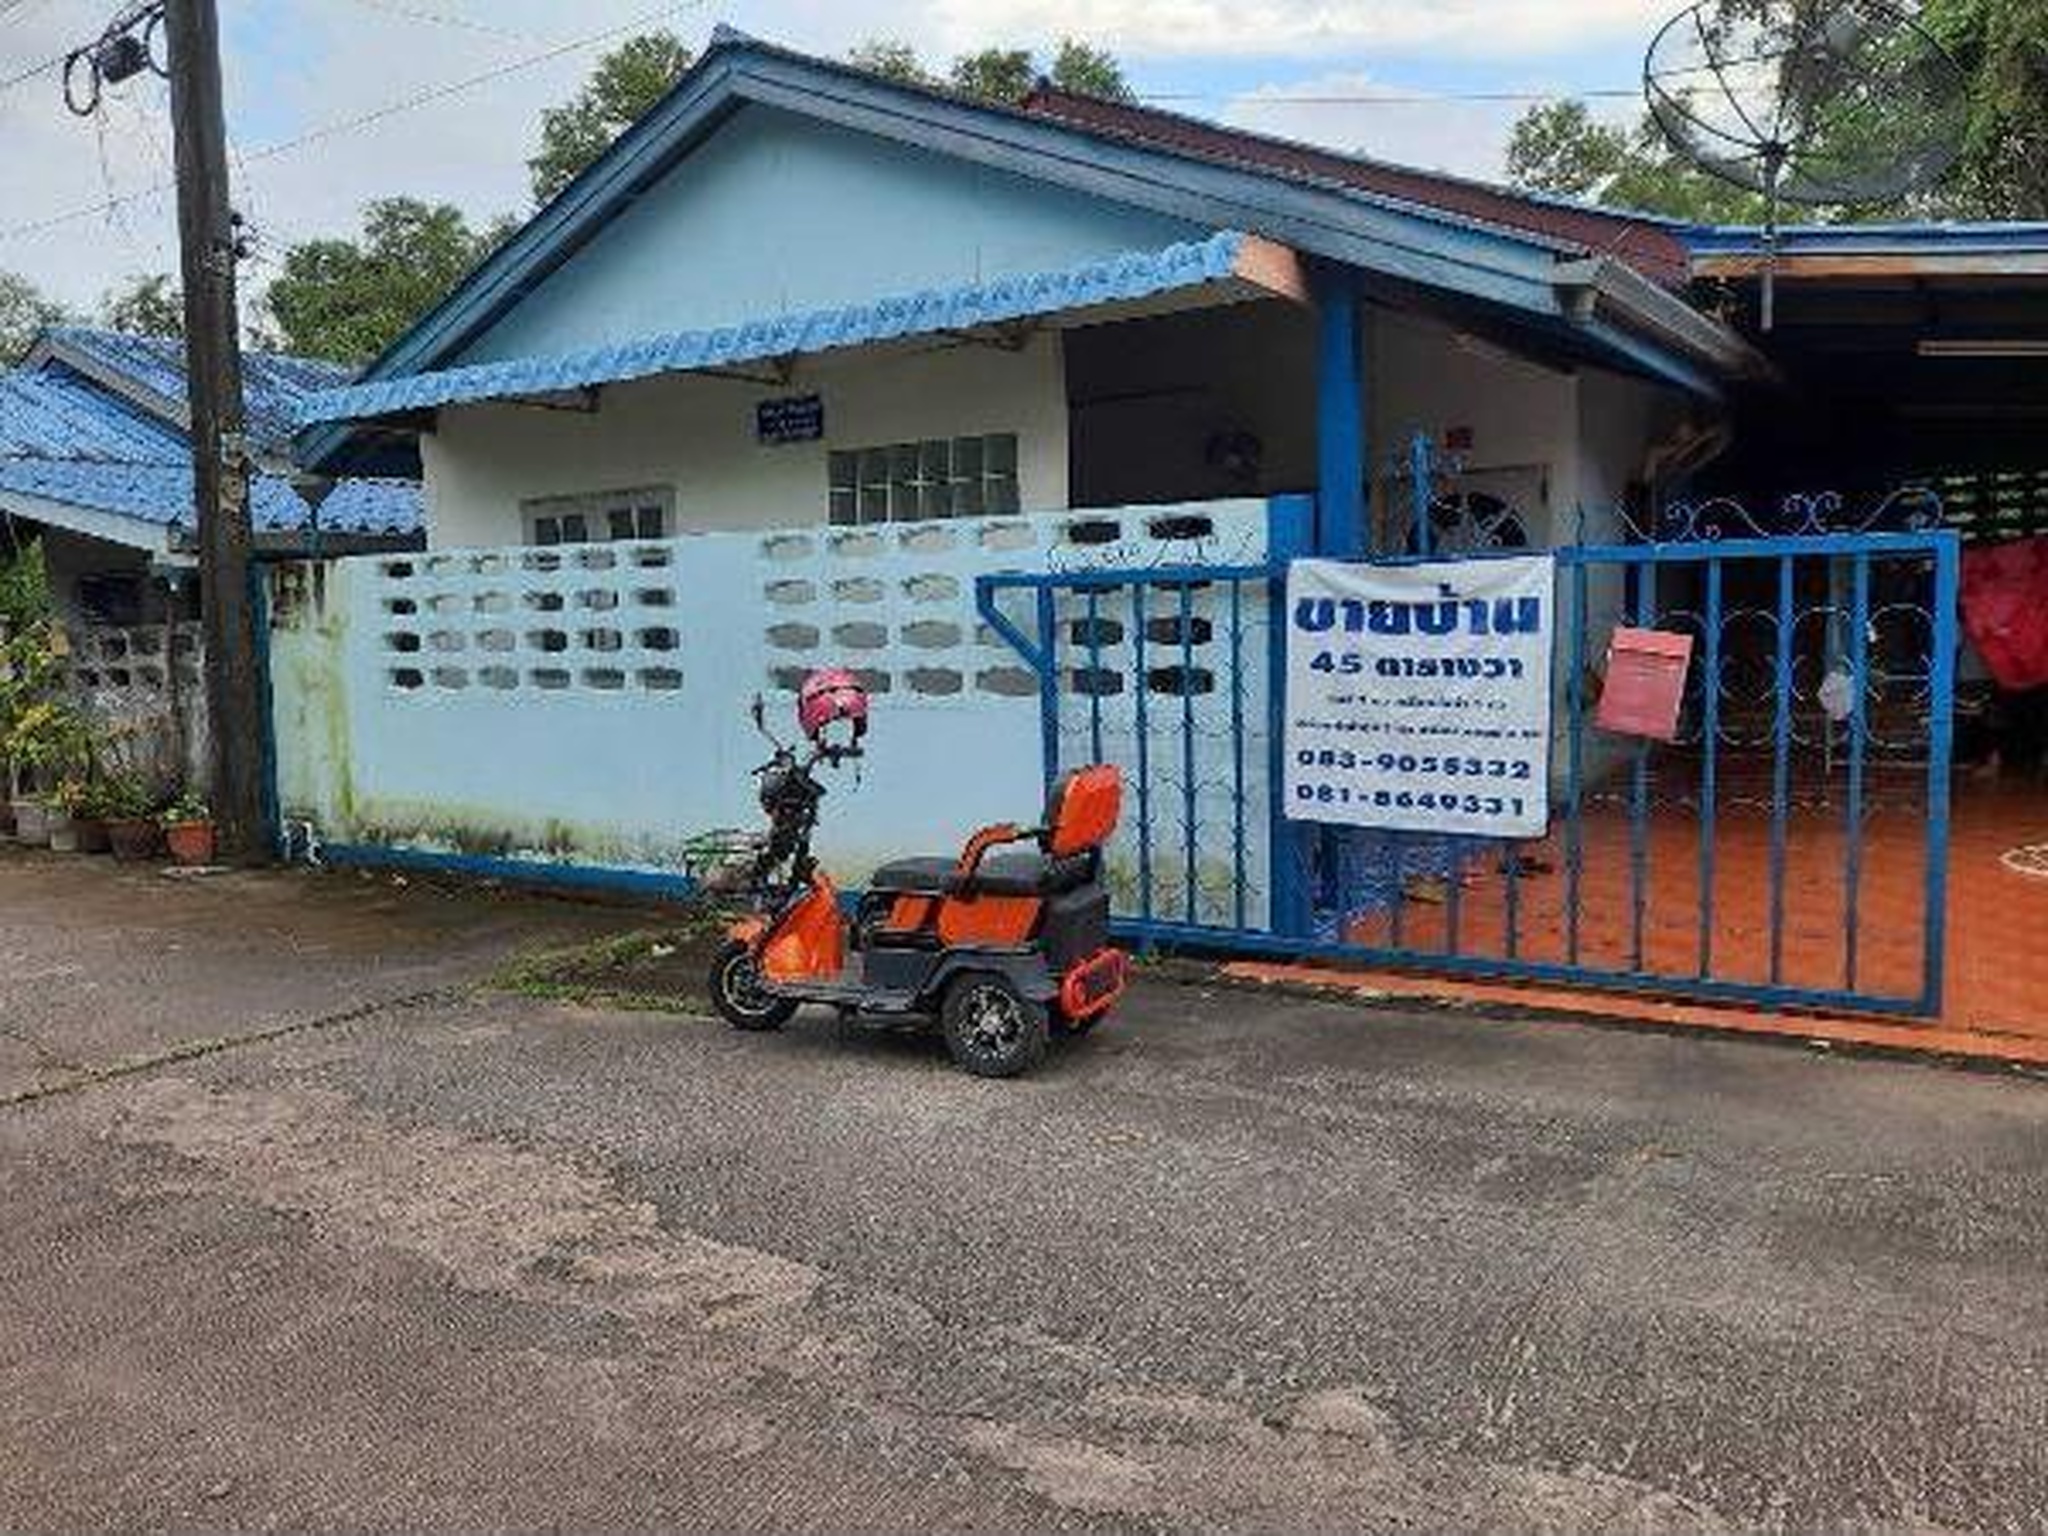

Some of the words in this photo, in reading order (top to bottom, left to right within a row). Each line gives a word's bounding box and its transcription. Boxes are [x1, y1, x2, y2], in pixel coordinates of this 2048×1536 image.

[1295, 583, 1540, 635] ขายบ้าน
[1310, 651, 1363, 674] 45
[1375, 657, 1523, 678] ตารางวา
